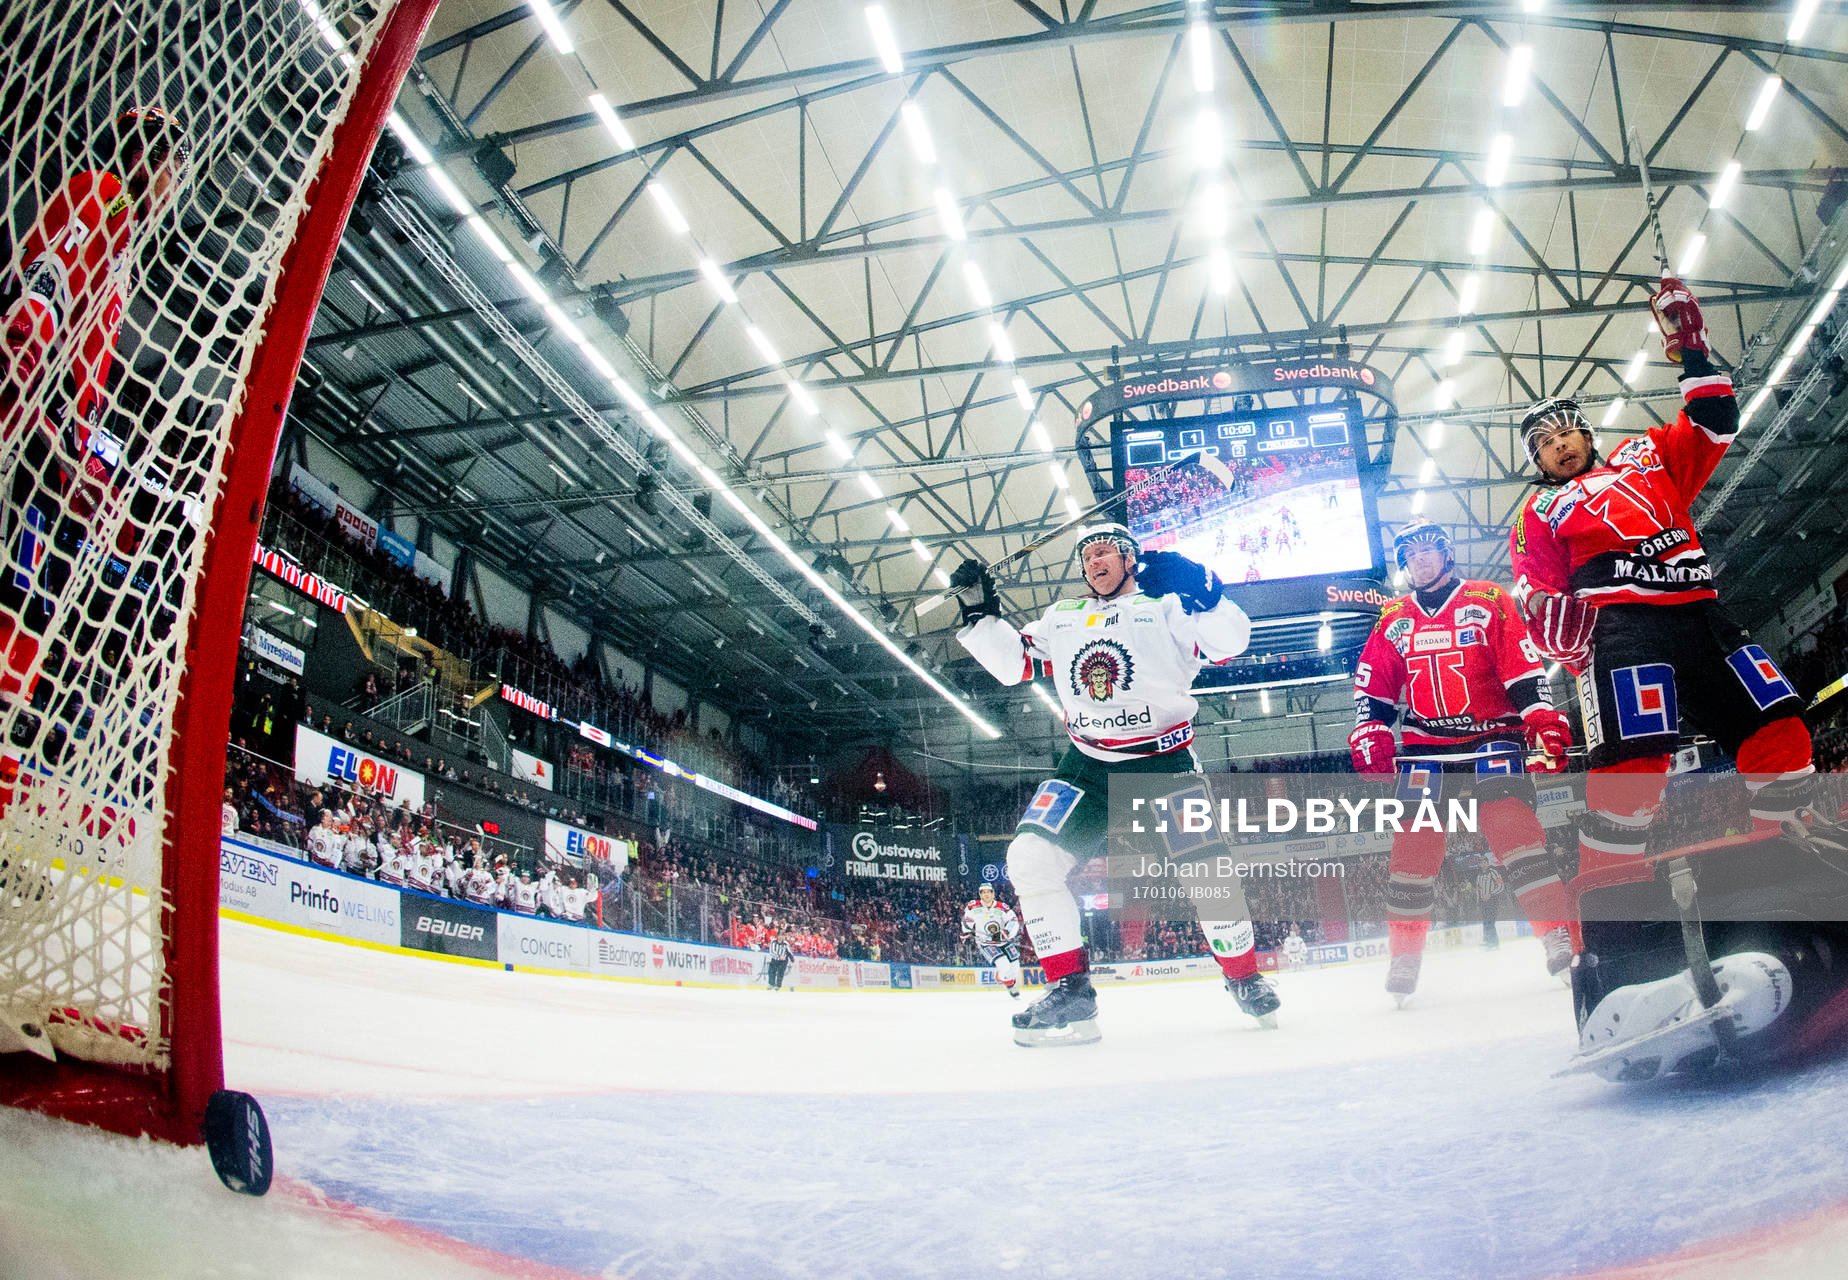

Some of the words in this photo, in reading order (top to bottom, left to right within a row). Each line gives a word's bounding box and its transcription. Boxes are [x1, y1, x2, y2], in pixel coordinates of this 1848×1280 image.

[1274, 364, 1359, 381] Swedbank
[1123, 376, 1210, 398] Swedbank
[1580, 663, 1601, 747] tructor
[1160, 726, 1191, 751] SKF
[327, 746, 399, 800] ELON
[1708, 768, 1737, 783] KPMG
[1537, 790, 1569, 805] gatan
[852, 832, 941, 861] Gustavsvik
[845, 861, 948, 881] FAMILJELÄKTARE
[291, 881, 340, 914] Prinfo
[343, 900, 395, 927] WELINS
[416, 916, 485, 941] BAUER
[666, 951, 707, 970] WÜRTH
[1353, 942, 1388, 959] ÖBA
[1146, 966, 1180, 976] Nolato
[246, 1102, 263, 1184] SHL
